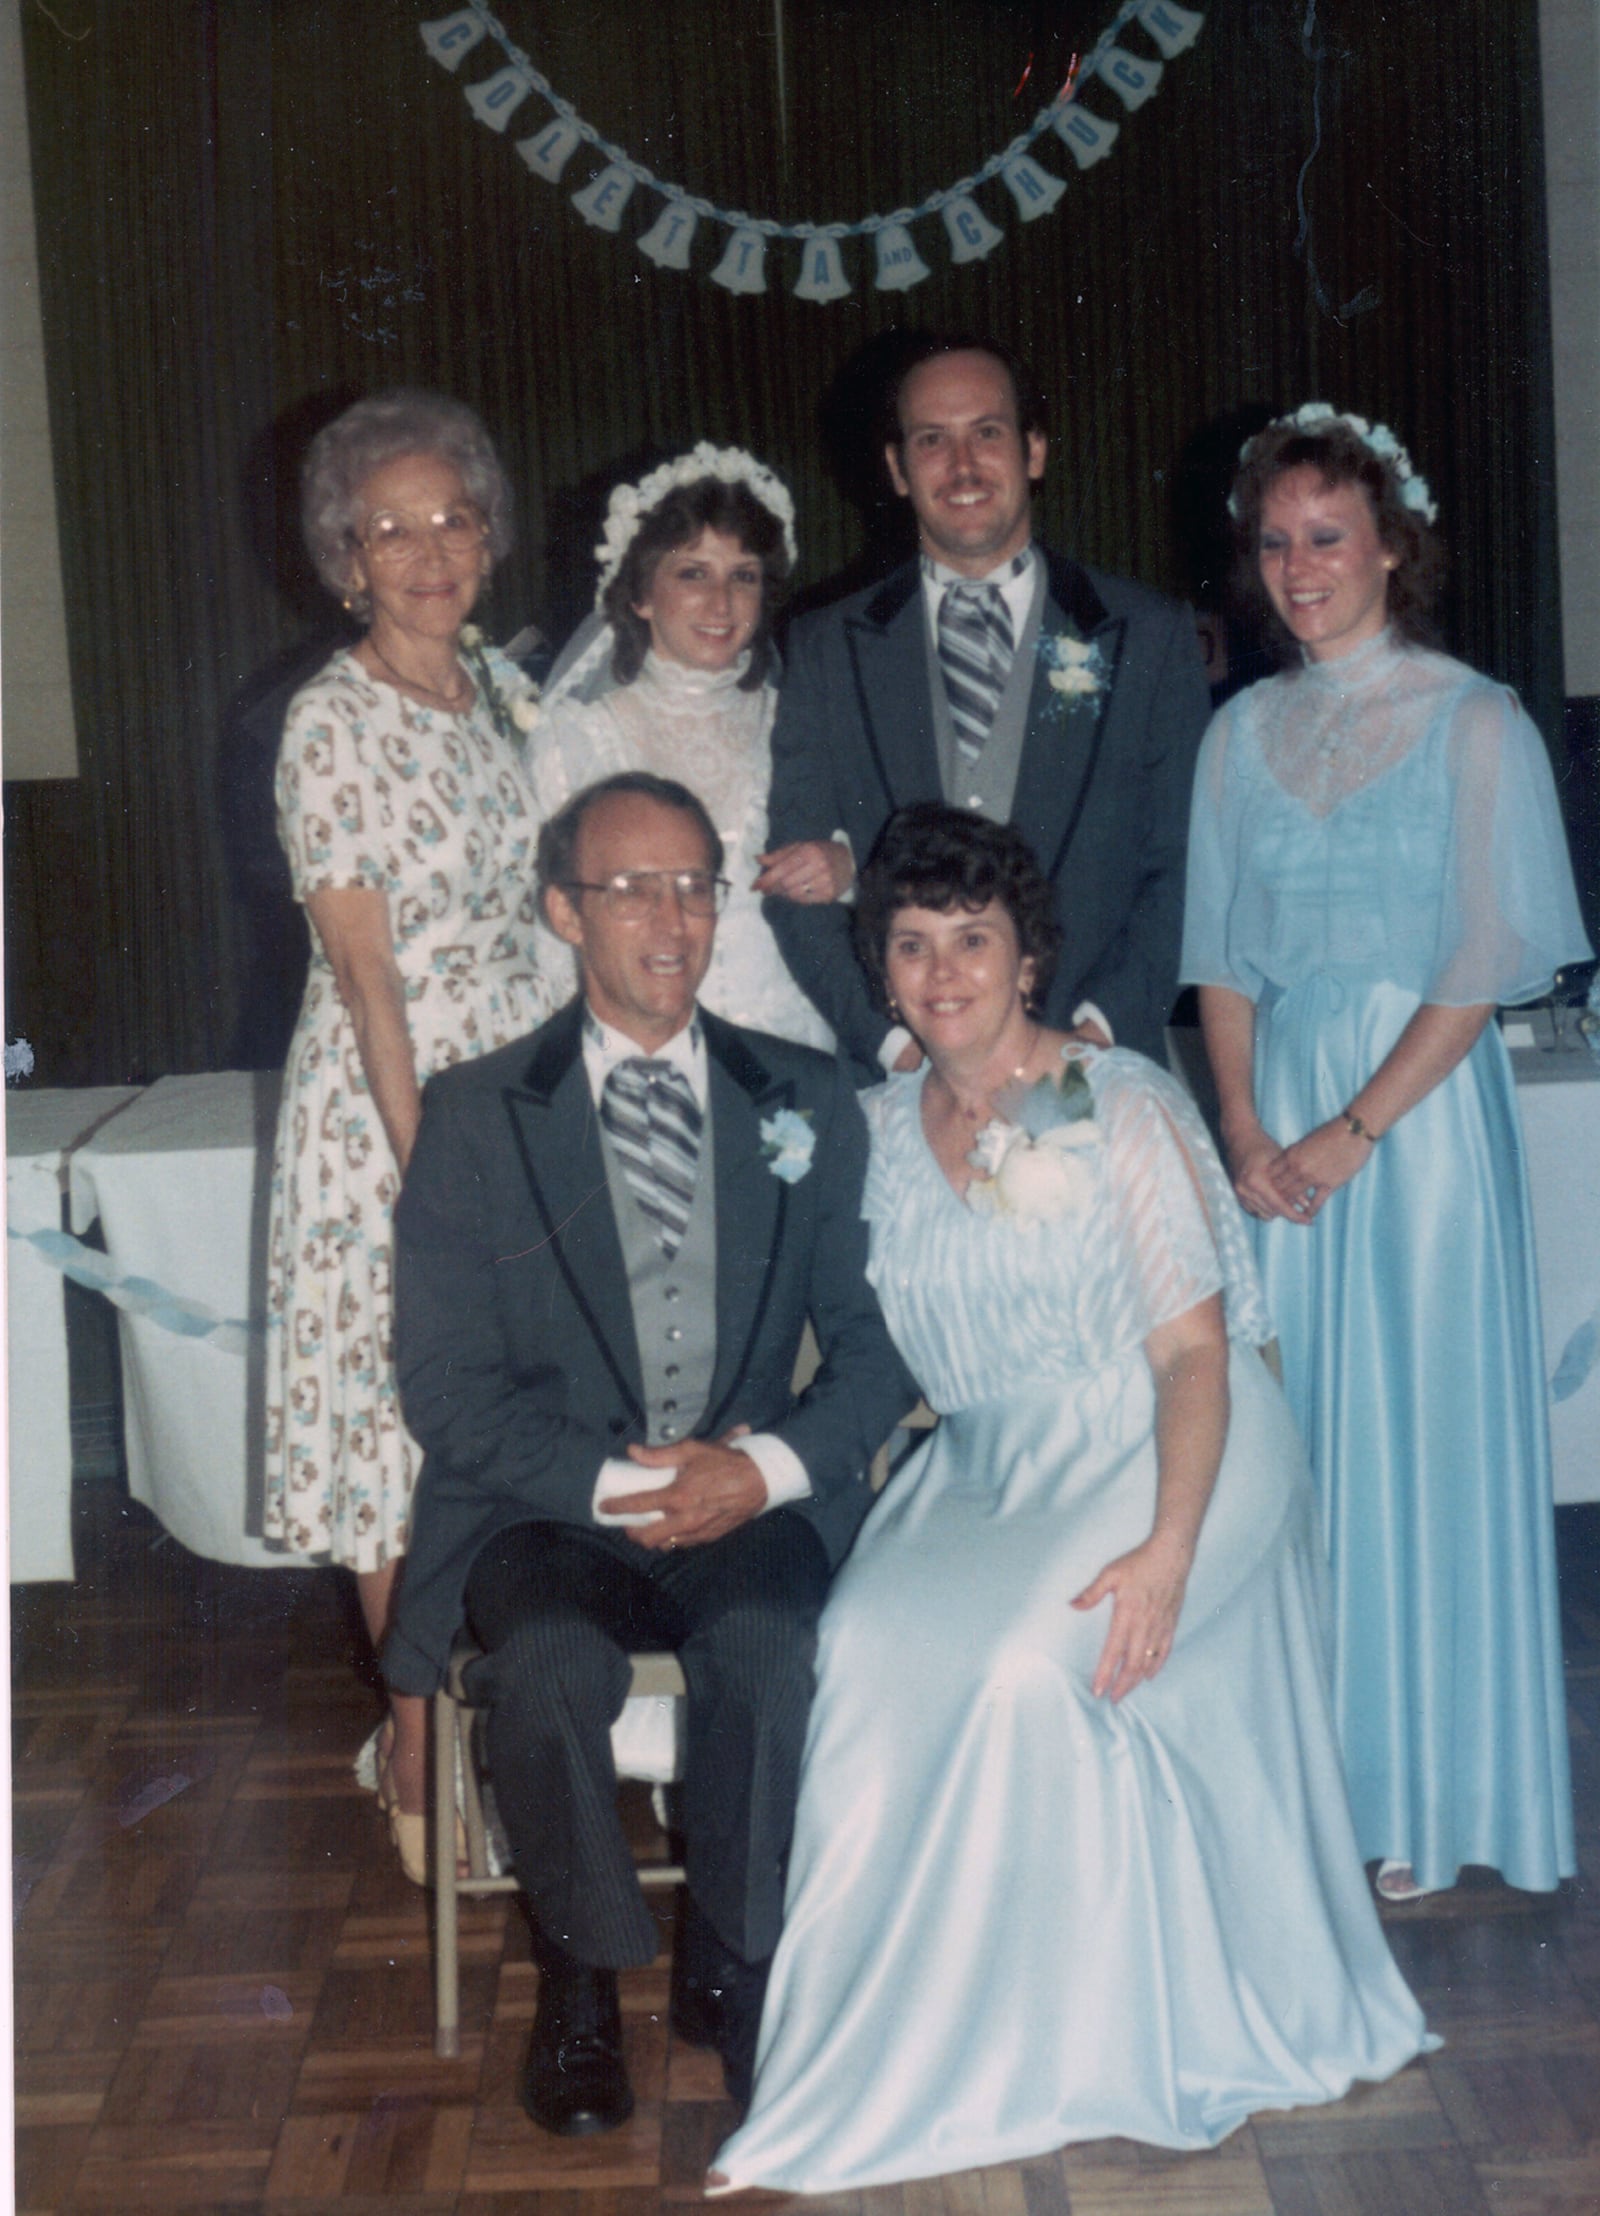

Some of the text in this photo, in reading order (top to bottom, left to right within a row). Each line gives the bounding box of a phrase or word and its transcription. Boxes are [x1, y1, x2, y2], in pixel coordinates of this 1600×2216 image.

[438, 3, 1185, 284] COLETTA AND CHUCK
